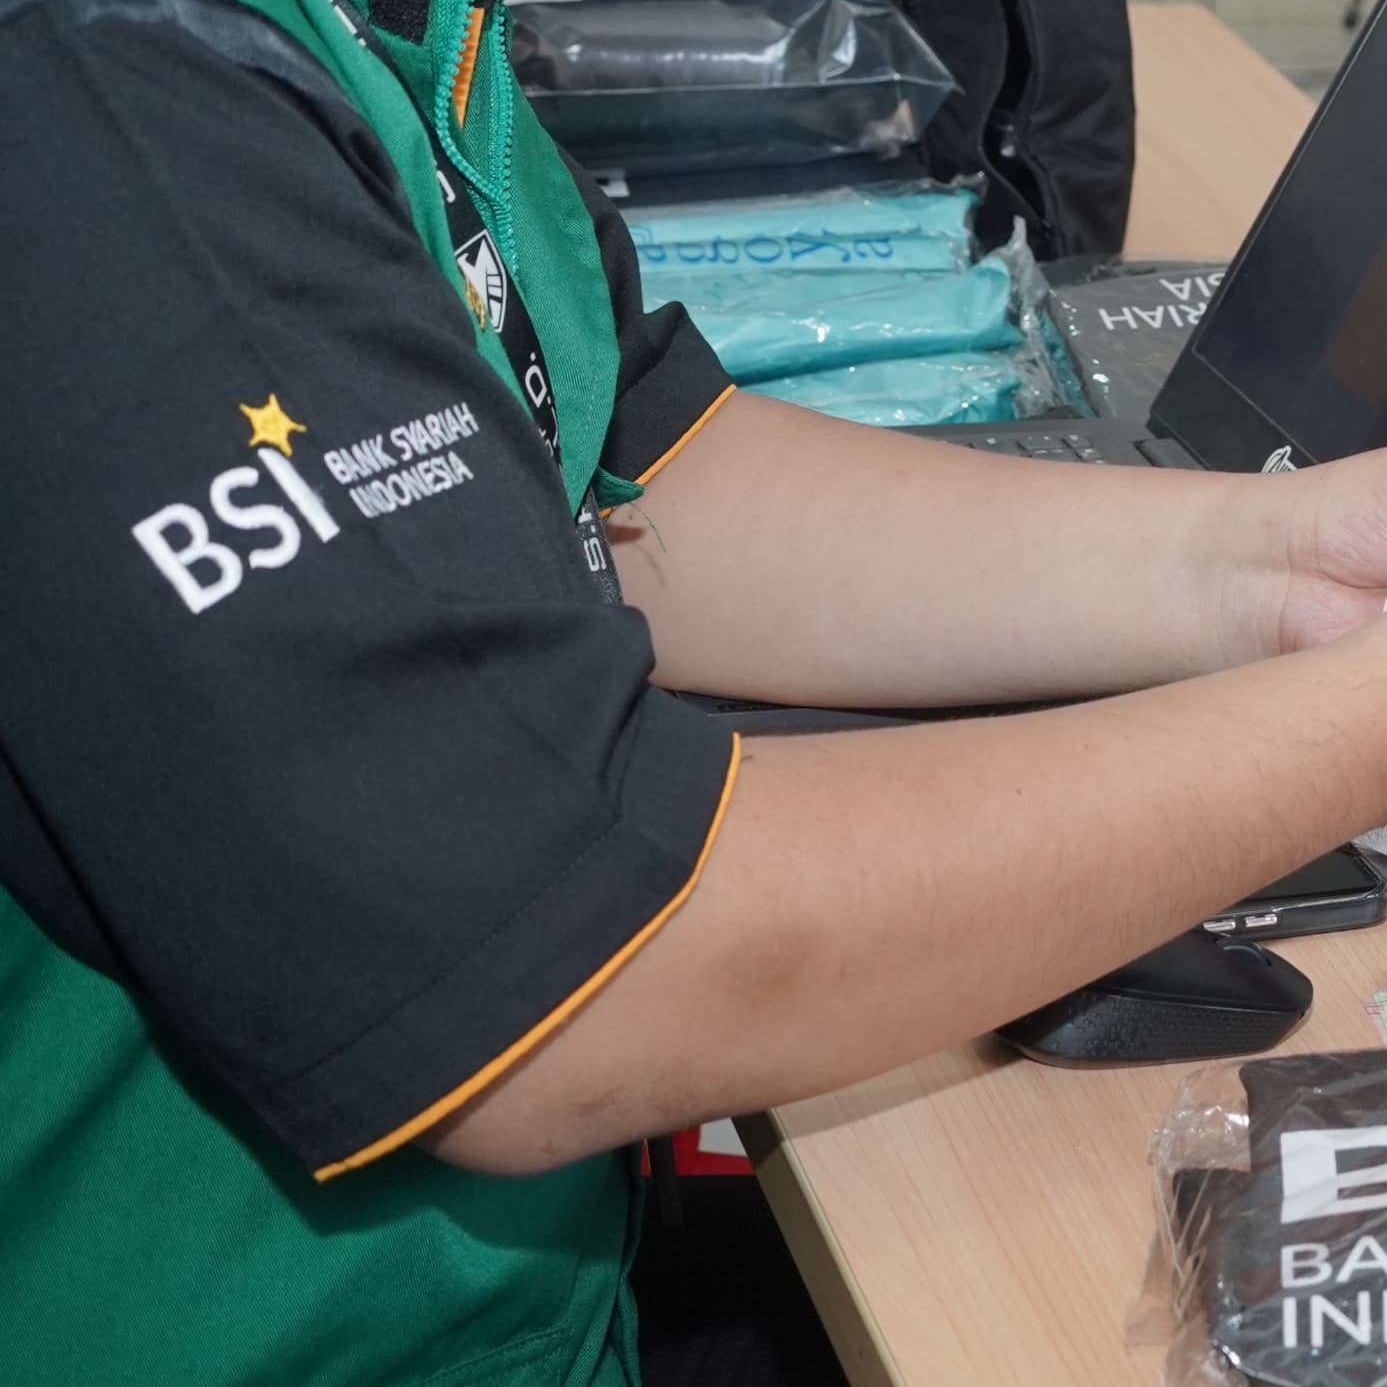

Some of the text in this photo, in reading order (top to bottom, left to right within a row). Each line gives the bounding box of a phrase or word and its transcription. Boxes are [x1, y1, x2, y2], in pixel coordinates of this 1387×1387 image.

[323, 433, 399, 485] BANK
[390, 401, 480, 462] SYARIAH
[350, 450, 475, 519] INDONESIA
[132, 447, 341, 614] BSI
